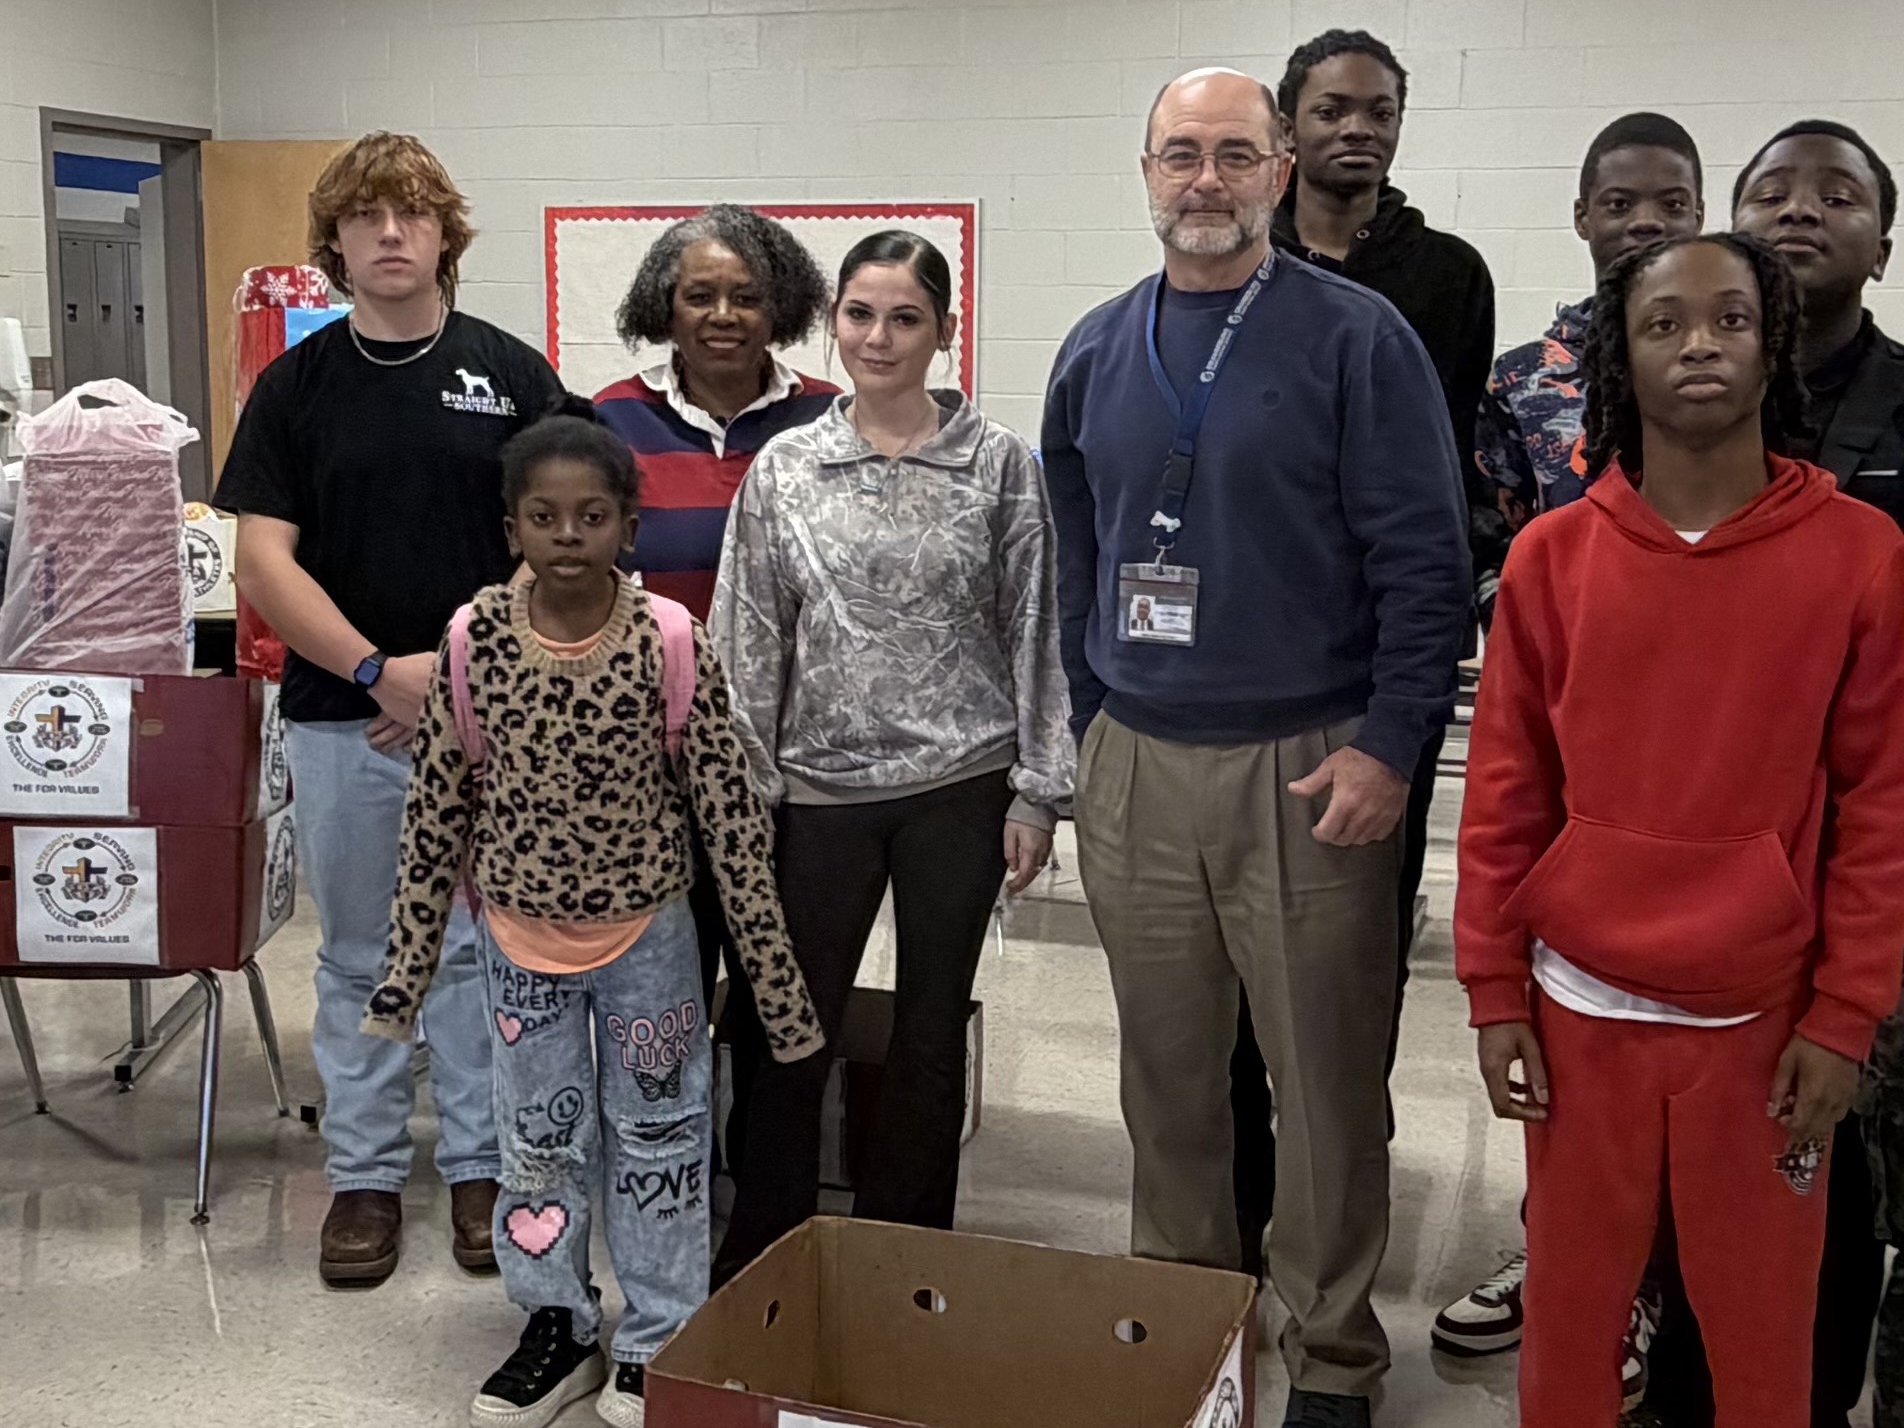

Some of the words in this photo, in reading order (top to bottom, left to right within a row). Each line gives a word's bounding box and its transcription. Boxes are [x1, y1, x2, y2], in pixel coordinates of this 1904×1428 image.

[12, 783, 33, 793] THE
[44, 934, 65, 943] THE
[491, 959, 562, 993] HAPPY
[524, 1008, 563, 1032] DAY
[605, 997, 698, 1046] GOOD
[621, 1035, 690, 1071] LUCK
